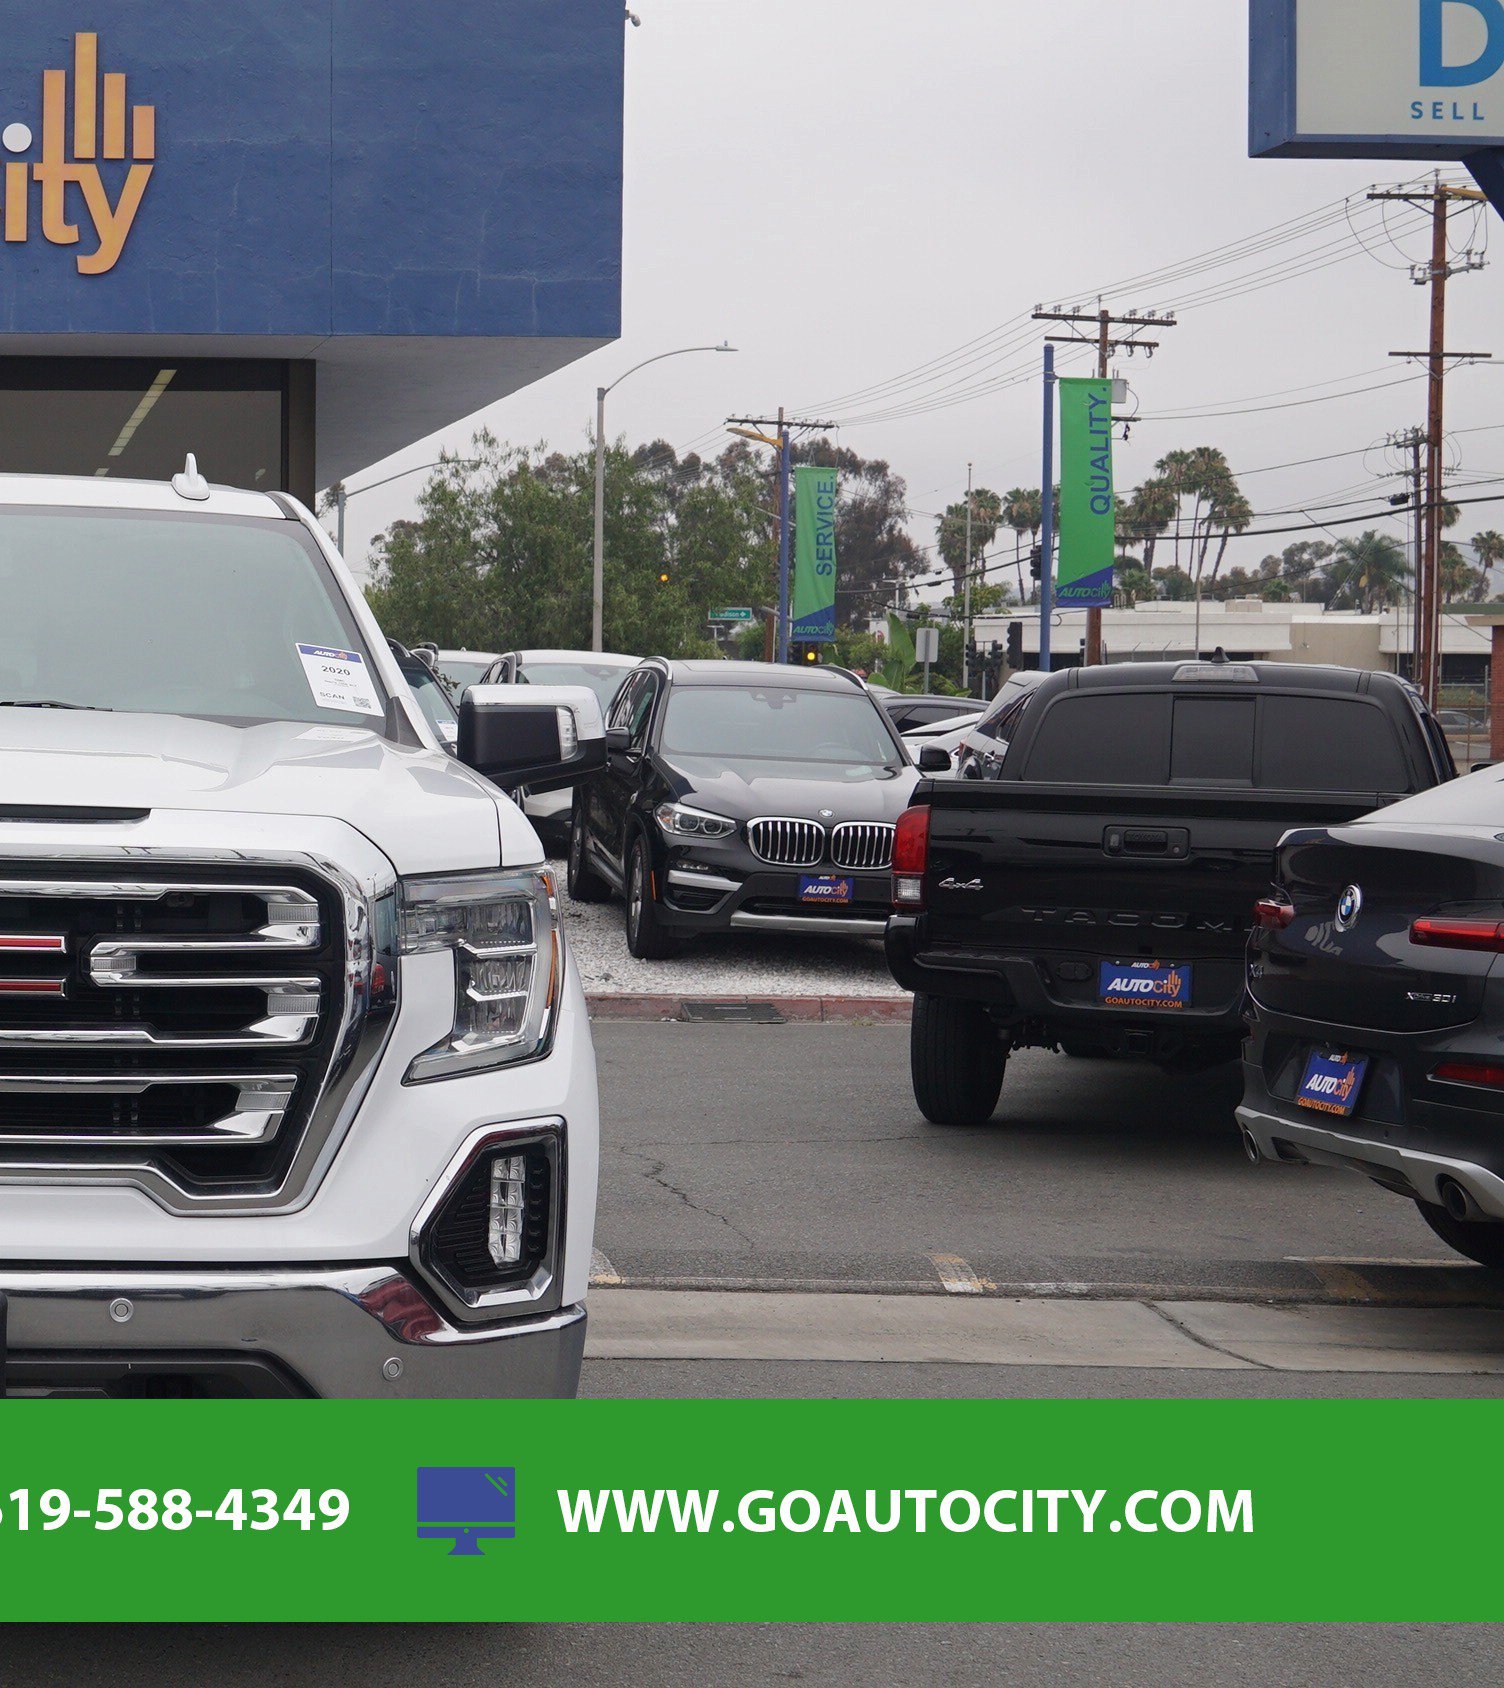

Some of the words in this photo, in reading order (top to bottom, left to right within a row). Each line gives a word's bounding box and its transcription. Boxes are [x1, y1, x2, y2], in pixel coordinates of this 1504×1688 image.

[1410, 101, 1485, 121] SELL
[1088, 383, 1112, 515] QUALITY.
[816, 475, 835, 577] SERVICE.
[321, 665, 351, 676] 2020
[319, 691, 346, 700] SCAN
[1021, 907, 1253, 931] TACOM
[1107, 970, 1182, 998] AUTOCity
[1105, 996, 1183, 1008] GOAUTOCITY.COM
[1305, 1066, 1356, 1102] AUTOCity
